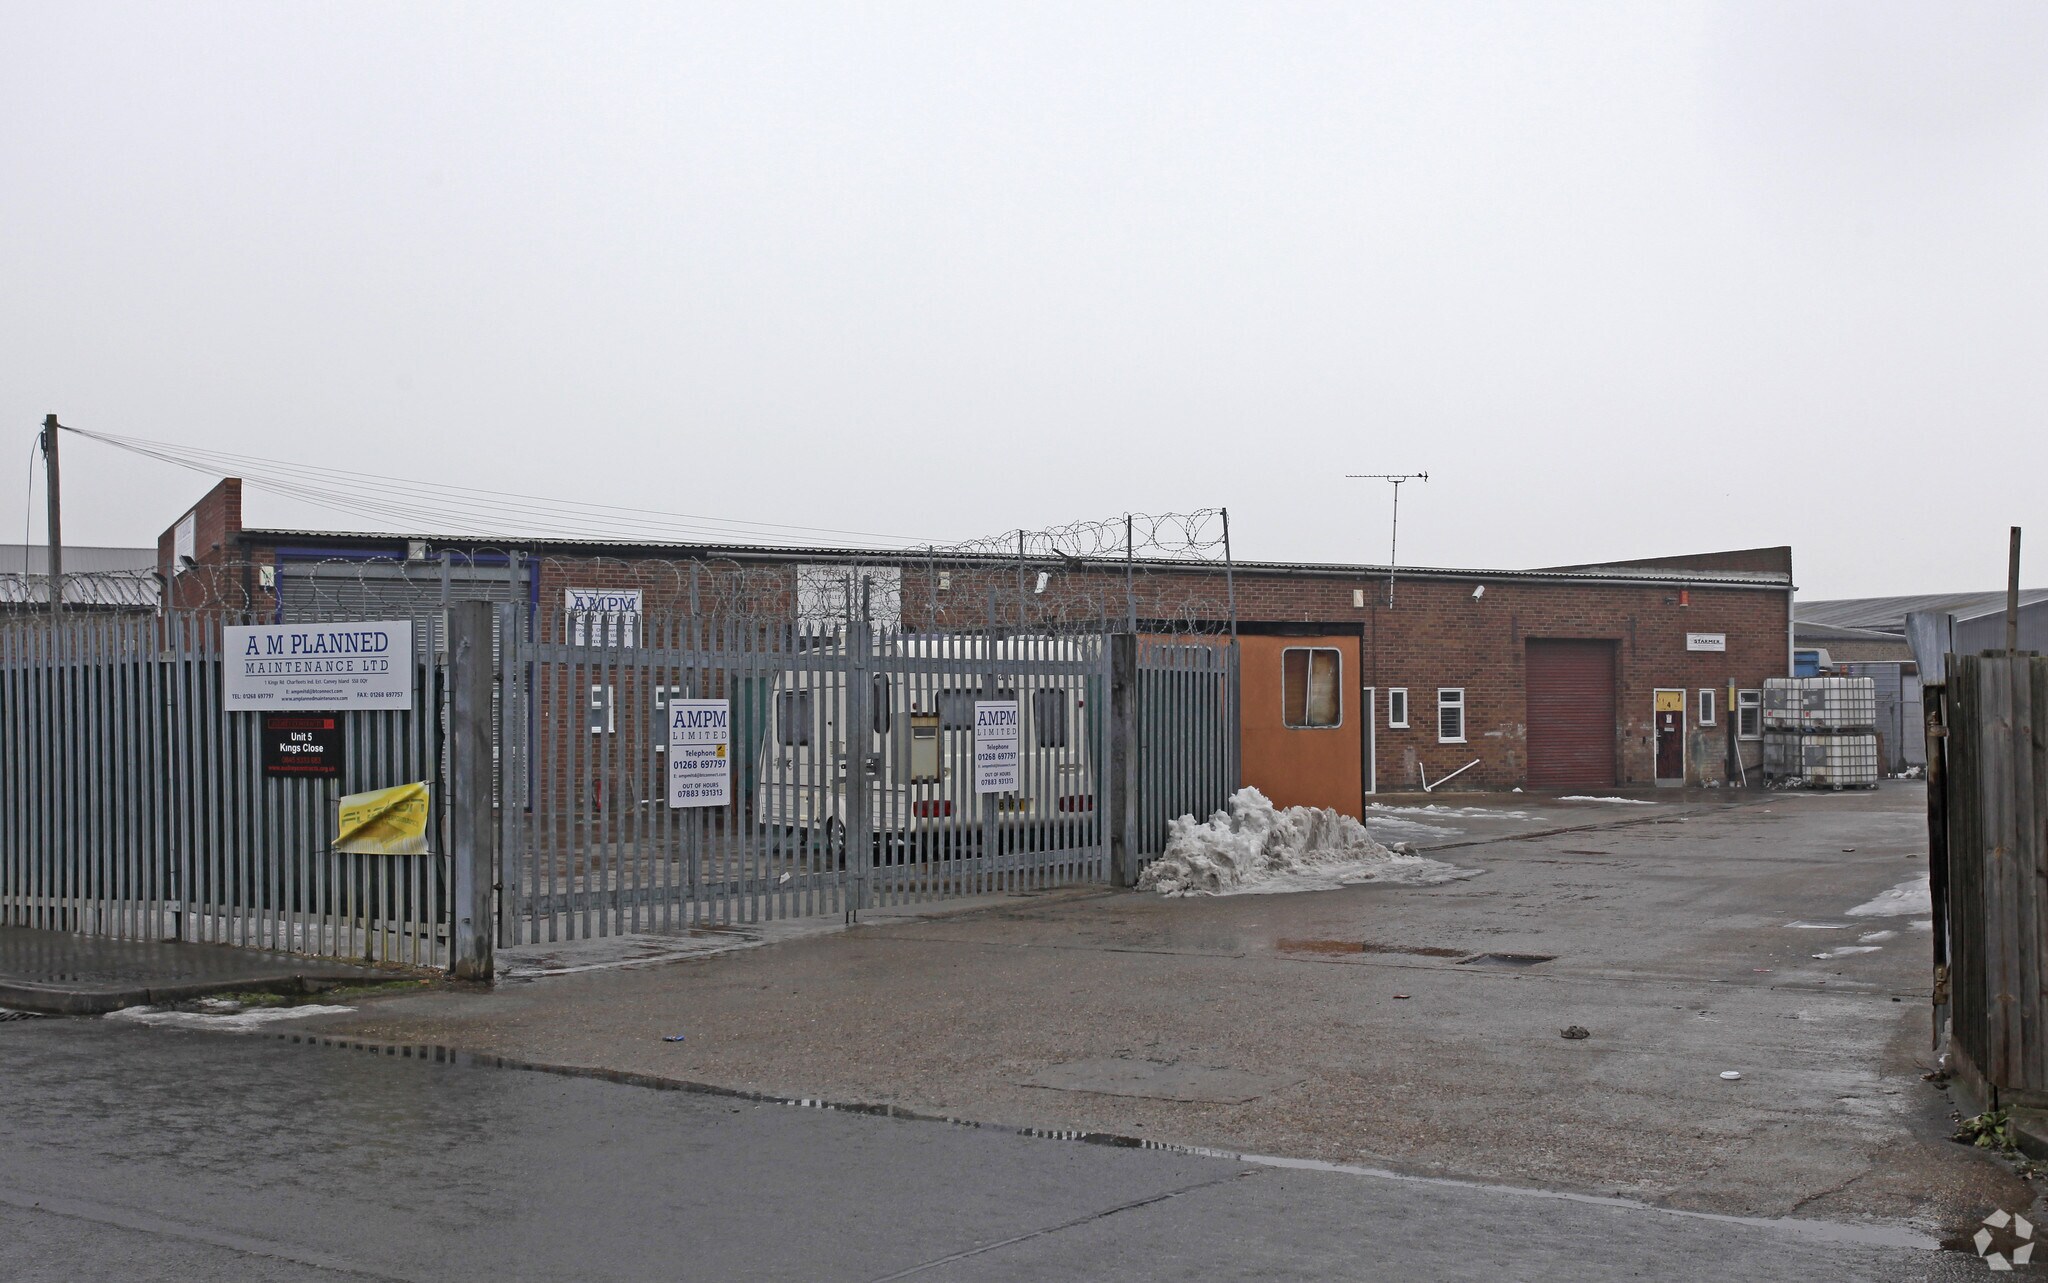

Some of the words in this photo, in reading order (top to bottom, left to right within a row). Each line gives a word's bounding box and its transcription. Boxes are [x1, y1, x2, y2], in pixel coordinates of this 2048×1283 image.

[573, 597, 635, 612] AMPM
[246, 636, 259, 655] A
[267, 635, 283, 654] M
[291, 632, 388, 653] PLANNED
[246, 661, 353, 673] MAINTENANCE
[363, 660, 389, 671] LTD
[673, 710, 727, 728] AMPM
[977, 710, 1017, 726] AMPM
[291, 732, 306, 741] Unit
[307, 732, 312, 741] 5
[672, 731, 727, 740] LIMITED
[977, 728, 1017, 736] LIMITED
[280, 743, 301, 754] Kings
[302, 743, 324, 753] Close
[685, 750, 716, 758] Telephone
[977, 753, 996, 761] 01268
[997, 752, 1016, 760] 697797
[673, 760, 698, 769] 01268
[700, 760, 726, 768] 697797
[677, 790, 699, 798] 07883
[701, 789, 723, 797] 931313
